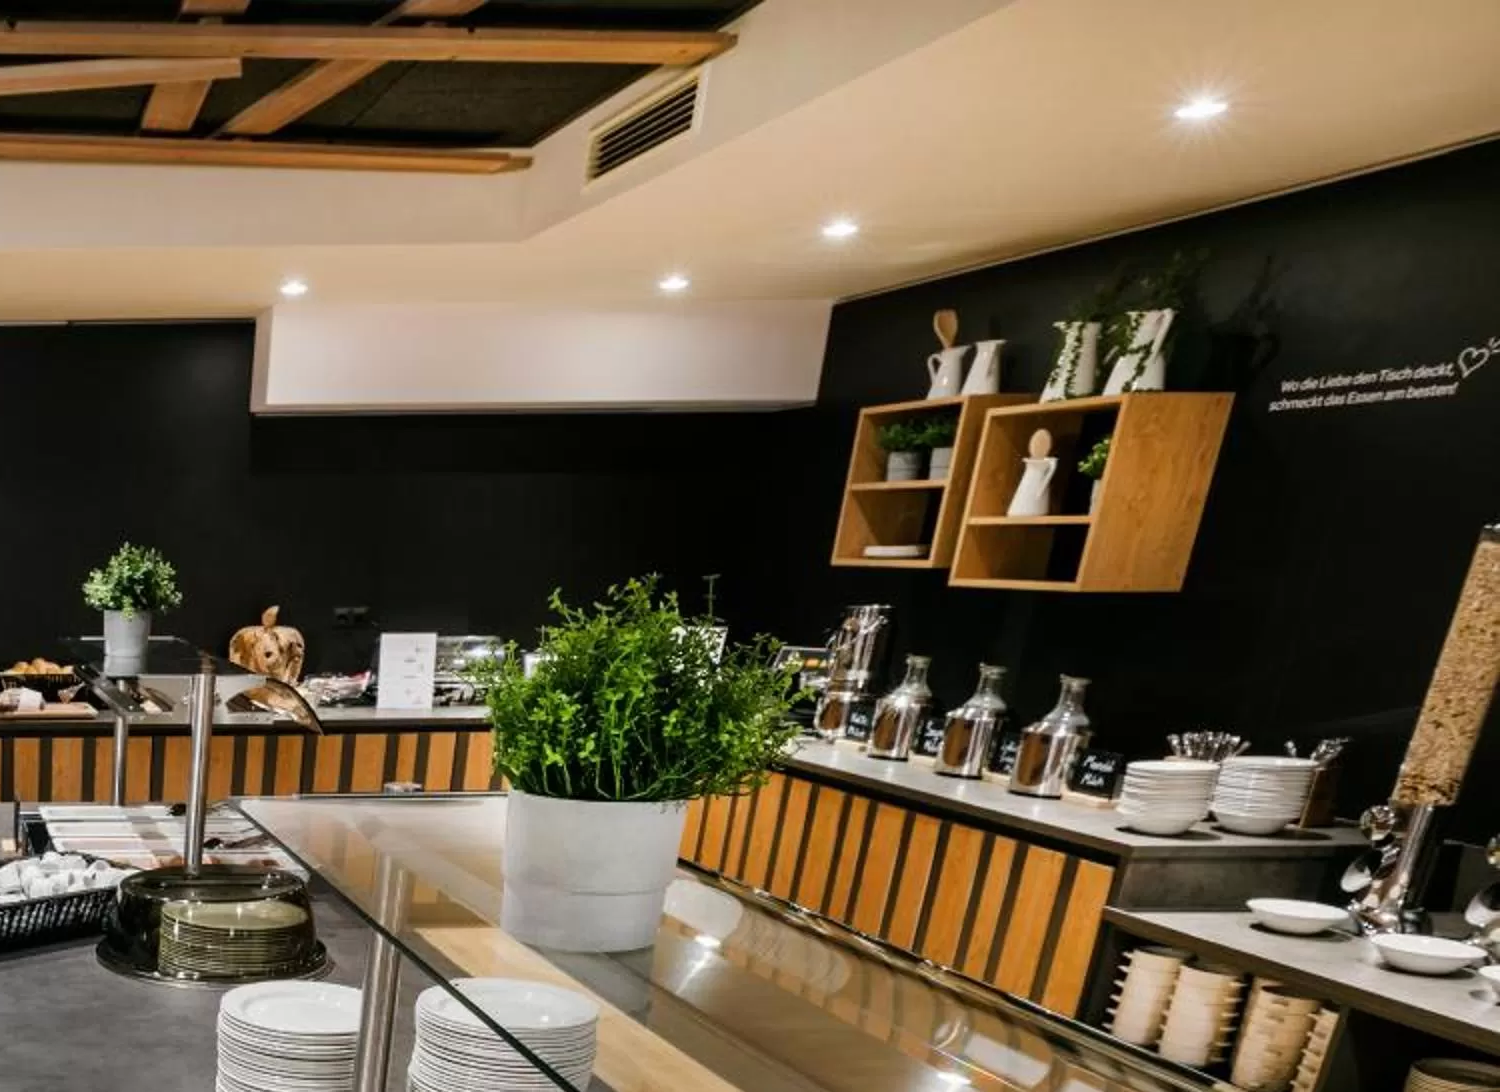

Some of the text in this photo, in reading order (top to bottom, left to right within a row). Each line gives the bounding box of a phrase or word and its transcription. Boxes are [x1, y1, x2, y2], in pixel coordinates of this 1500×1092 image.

[1281, 379, 1300, 393] Wo
[1300, 376, 1319, 391] die
[1319, 374, 1353, 389] Liebe
[1353, 371, 1378, 386] den
[1380, 368, 1413, 383] Tisch
[1268, 396, 1323, 412] schmeckt
[1324, 393, 1346, 407] das
[1347, 389, 1384, 405] Essen
